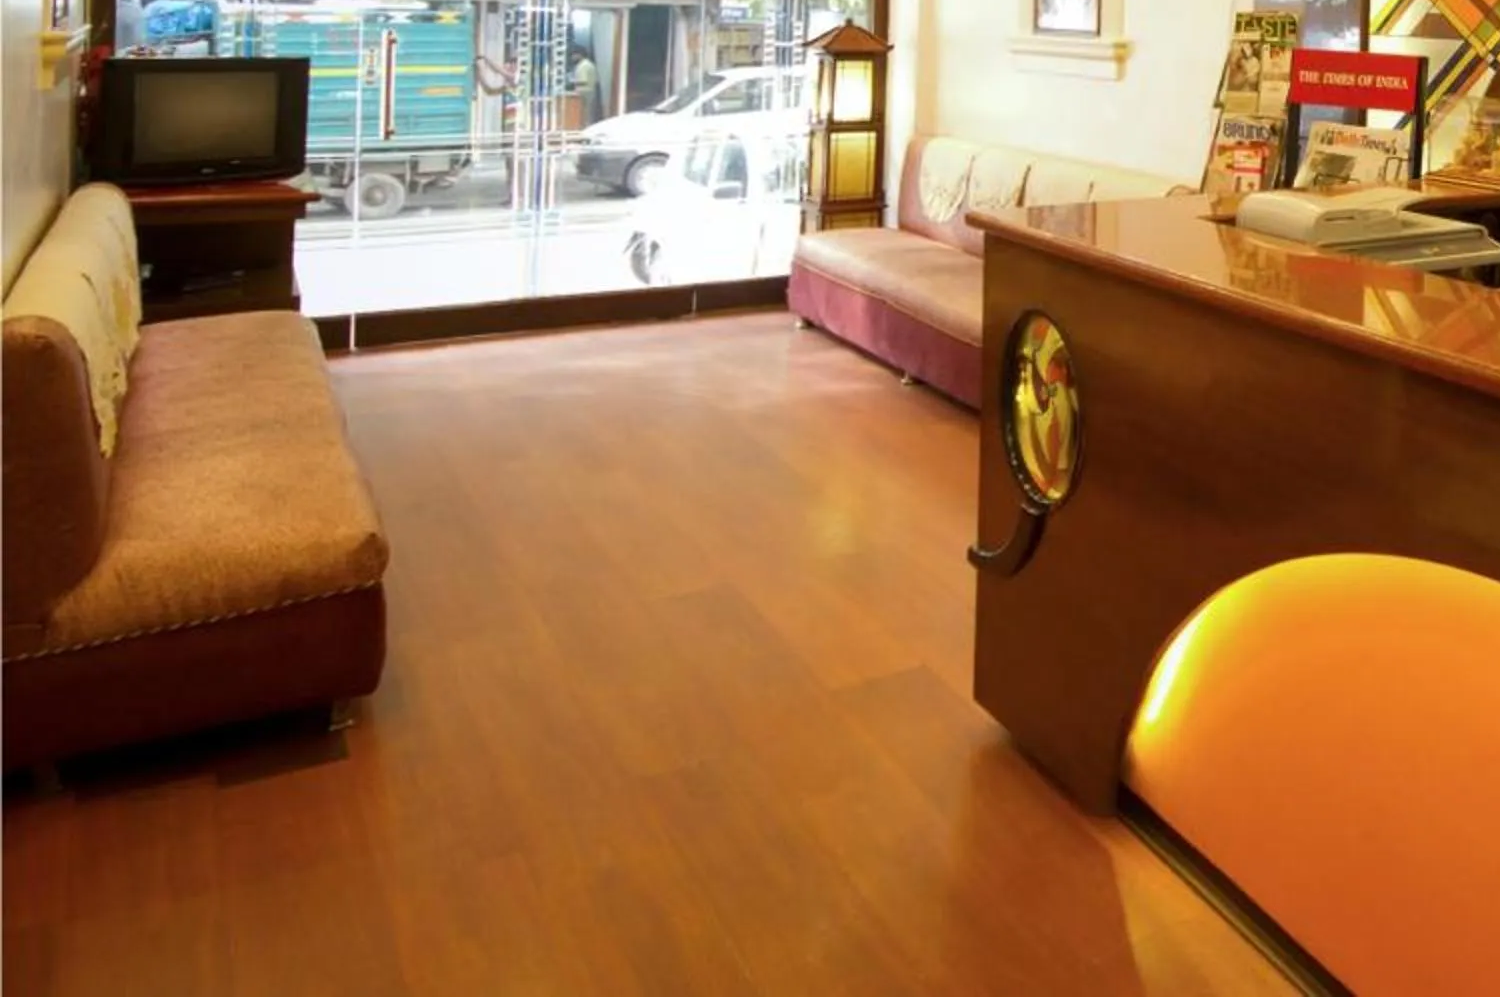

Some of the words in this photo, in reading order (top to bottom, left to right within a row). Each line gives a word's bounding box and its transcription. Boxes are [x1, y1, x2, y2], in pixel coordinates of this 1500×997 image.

[1237, 17, 1297, 41] TASTE
[1298, 70, 1320, 83] THE
[1322, 71, 1356, 86] TIMES
[1358, 74, 1374, 87] OF
[1375, 76, 1409, 90] INDIA
